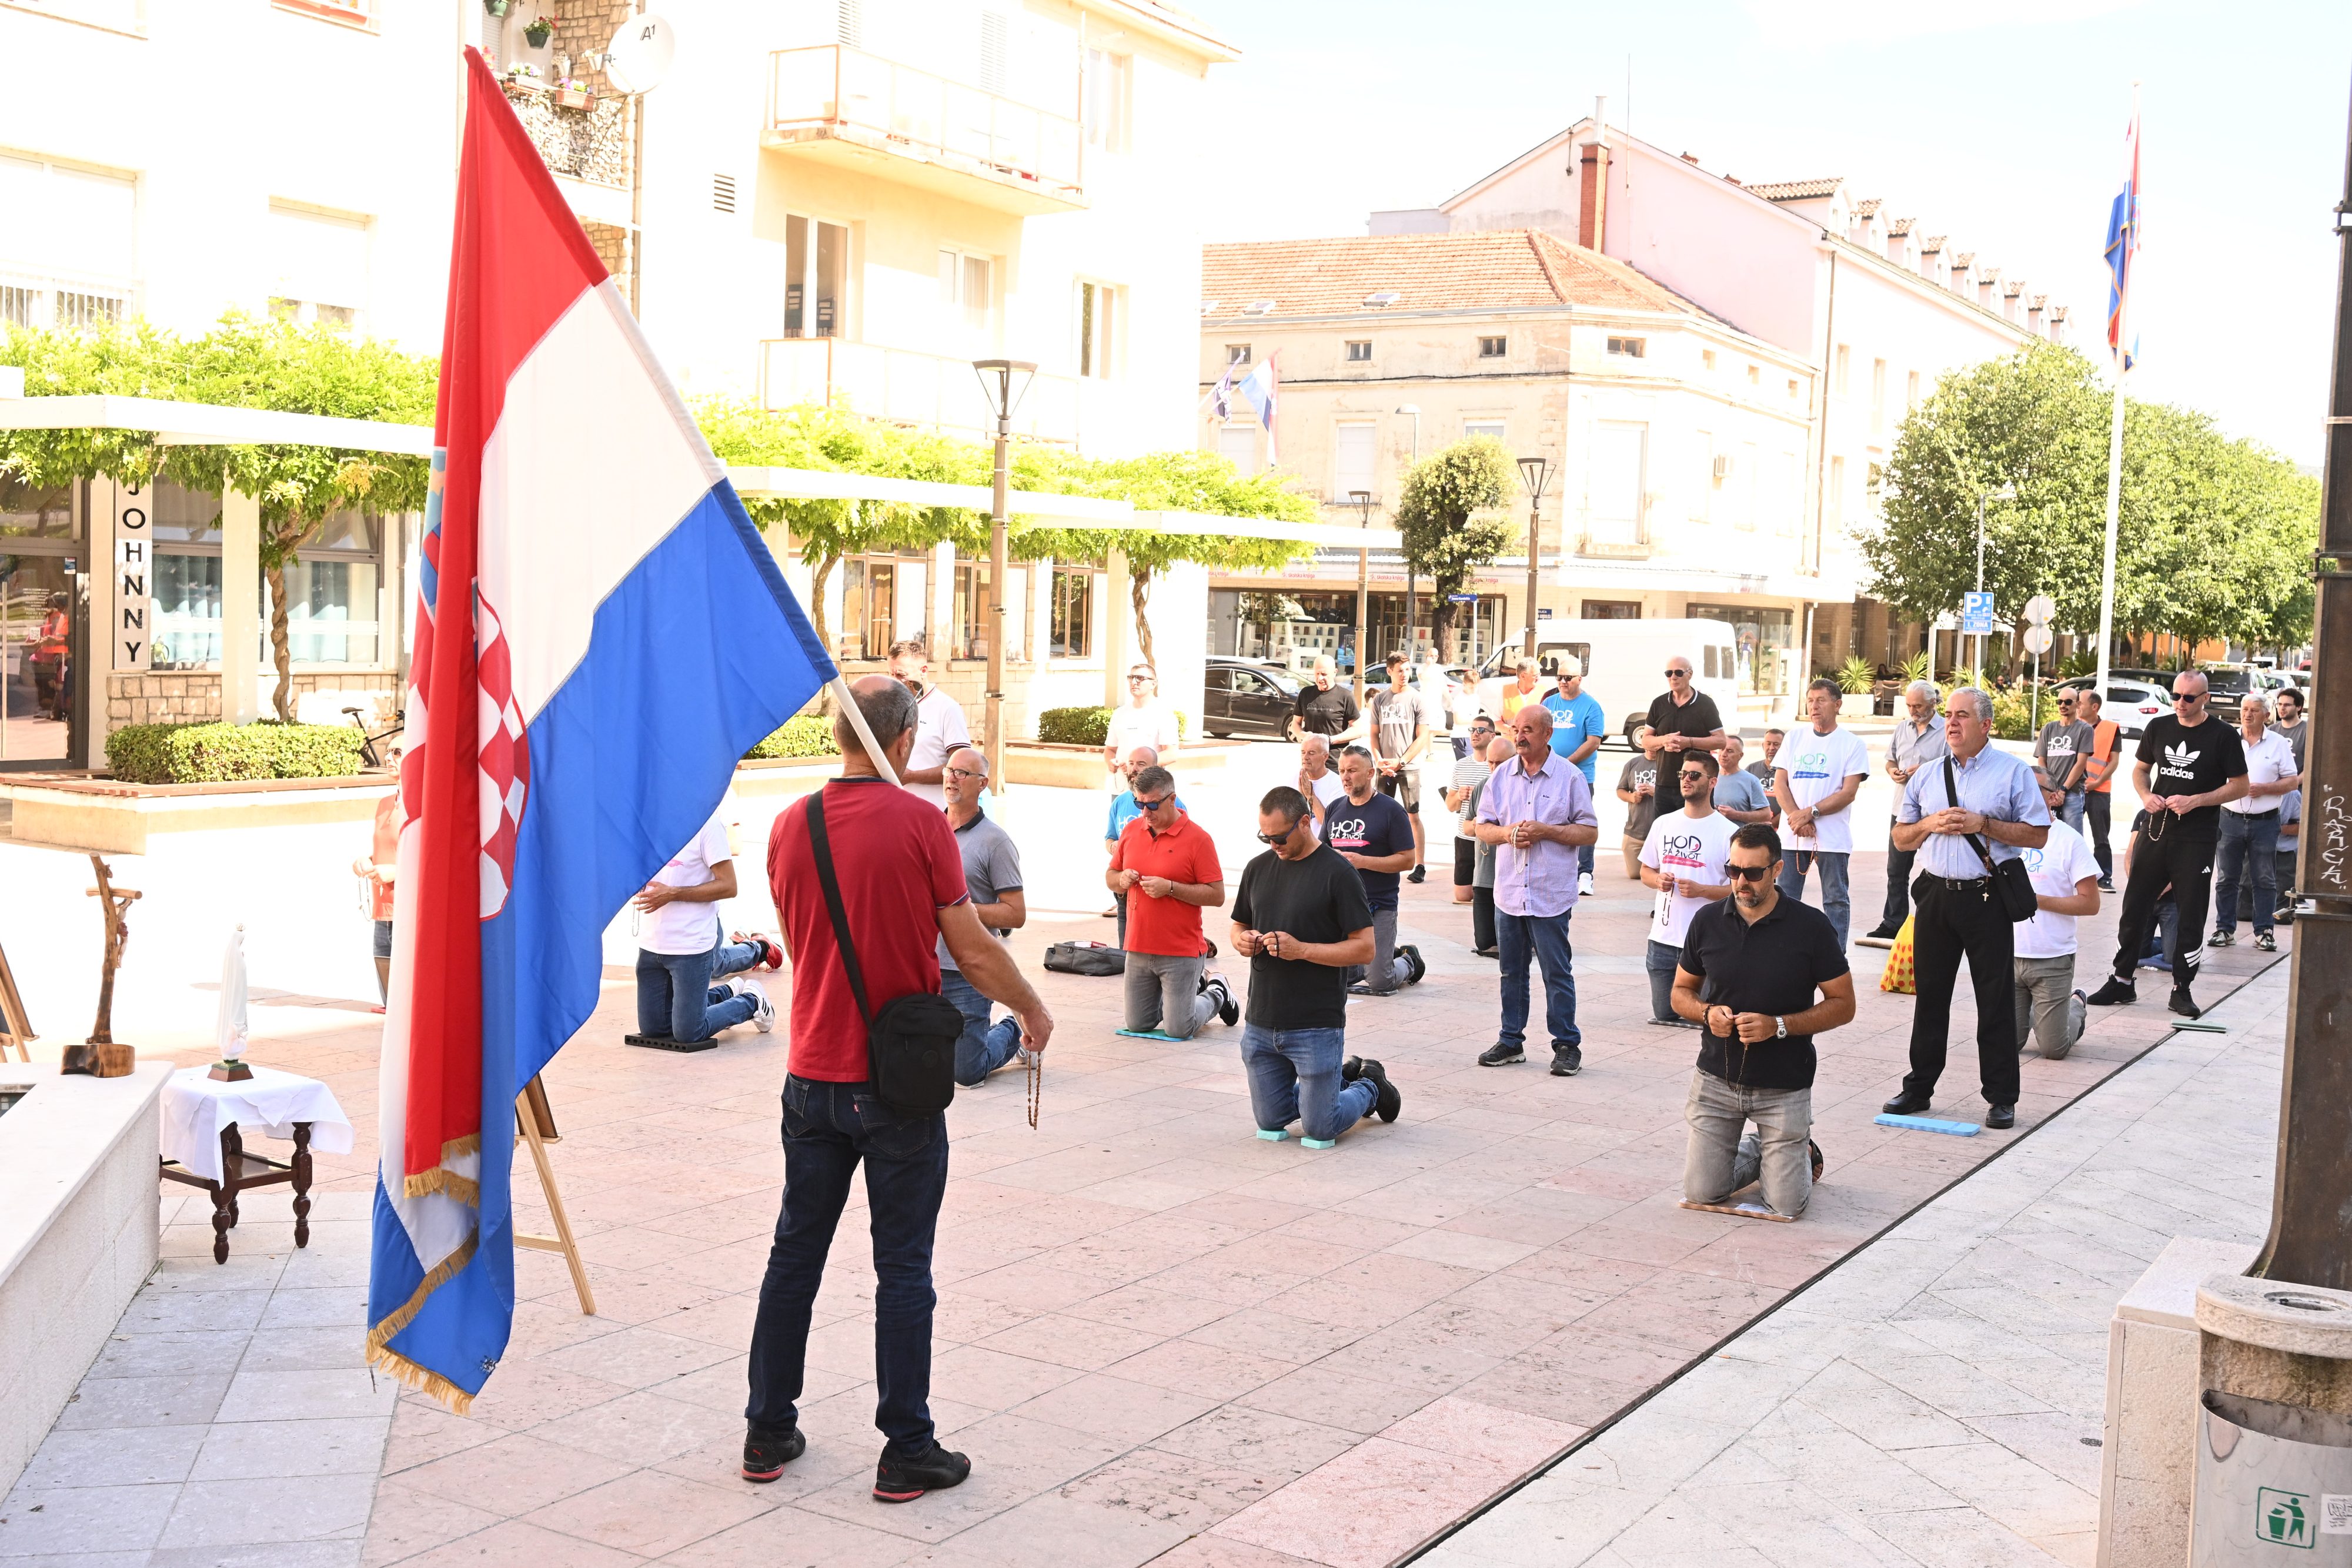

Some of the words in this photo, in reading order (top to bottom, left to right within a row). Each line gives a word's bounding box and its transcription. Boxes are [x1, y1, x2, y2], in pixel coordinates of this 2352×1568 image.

[1966, 594, 1982, 613] P
[1793, 753, 1827, 766] HOD
[2160, 766, 2194, 780] adidas
[1331, 818, 1366, 834] HOD
[1329, 831, 1340, 840] ZA
[1663, 834, 1702, 853] HOD
[1662, 847, 1673, 857] ZA
[1675, 849, 1702, 861] ŽIVOT
